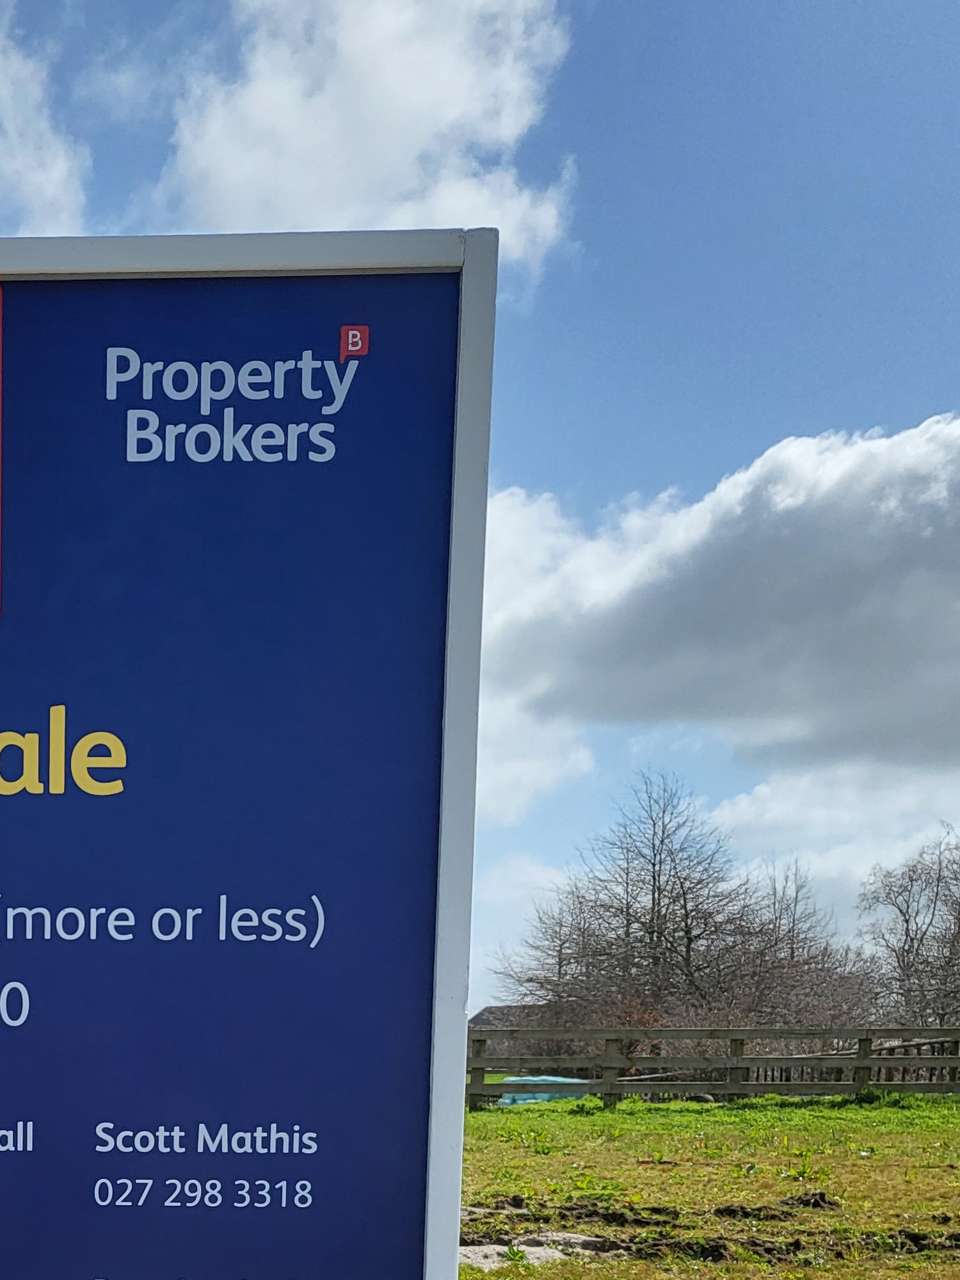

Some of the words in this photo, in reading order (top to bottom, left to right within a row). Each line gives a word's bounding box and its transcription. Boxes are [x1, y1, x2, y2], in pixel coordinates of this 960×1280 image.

[348, 330, 362, 351] B
[106, 346, 360, 416] Property
[126, 407, 336, 464] Brokers
[151, 907, 203, 941] or
[219, 894, 325, 949] less)
[95, 1122, 186, 1153] Scott
[197, 1122, 318, 1154] Mathis
[94, 1178, 154, 1206] 027
[165, 1179, 223, 1207] 298
[233, 1180, 313, 1208] 3318
